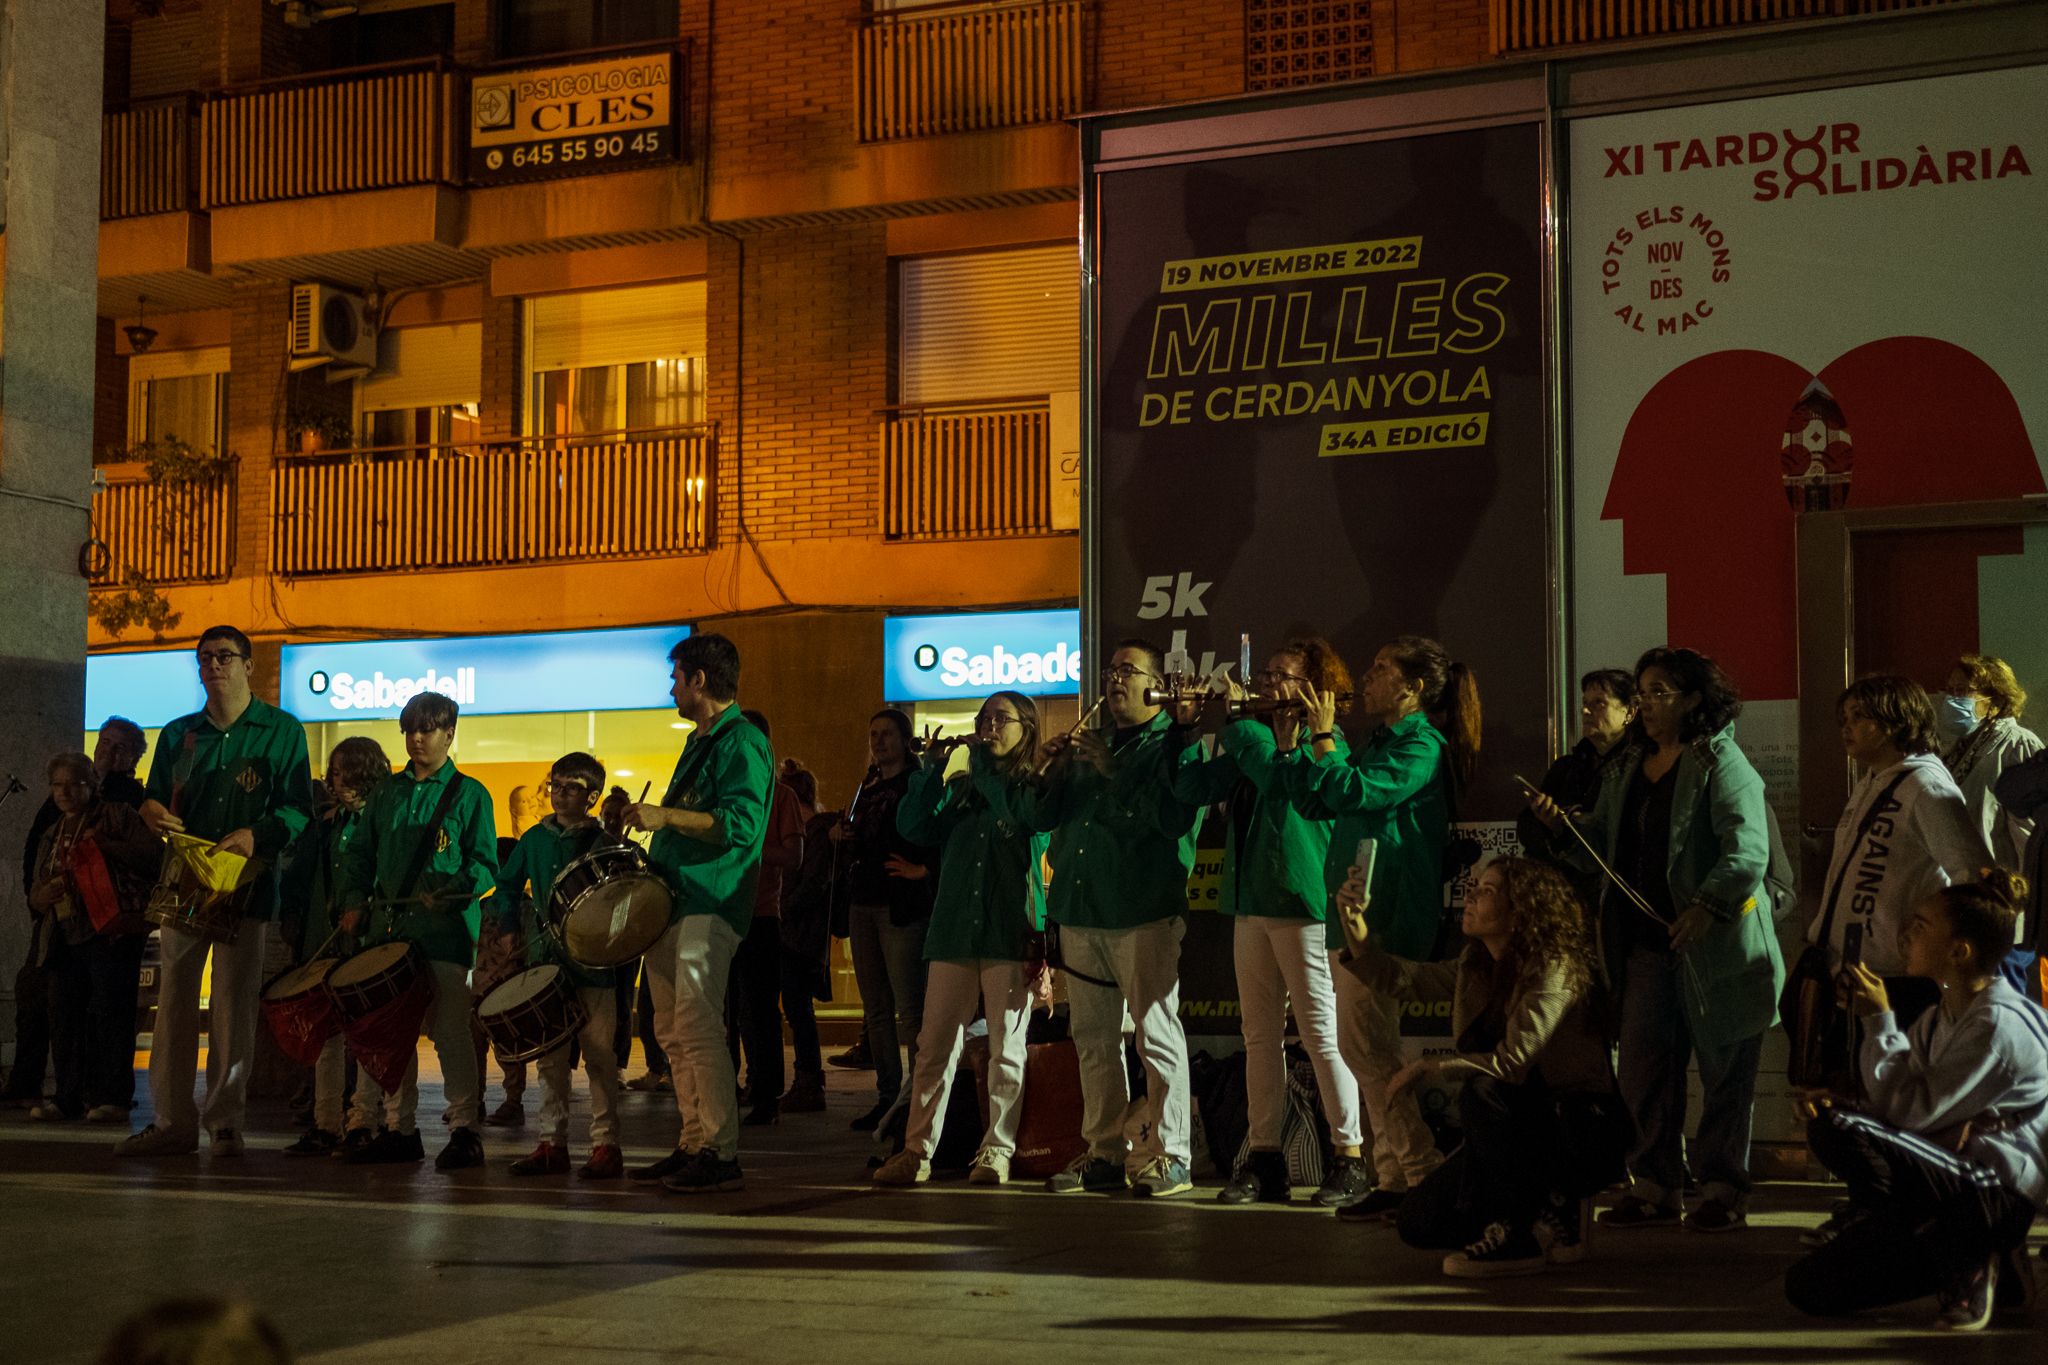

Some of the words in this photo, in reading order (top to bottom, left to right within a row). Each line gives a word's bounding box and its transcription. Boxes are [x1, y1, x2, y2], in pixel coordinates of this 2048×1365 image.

[518, 64, 668, 103] PSICOLOGIA
[531, 92, 655, 132] CLES
[512, 143, 555, 167] 645
[560, 140, 588, 162] 55
[594, 135, 624, 158] 90
[630, 131, 660, 154] 45
[1603, 144, 1644, 178] XI
[1167, 262, 1191, 285] 19
[1199, 250, 1347, 282] NOVEMBRE
[1355, 243, 1417, 266] 2022
[1602, 227, 1634, 294] TOTS
[1636, 206, 1684, 230] ELS
[1689, 212, 1731, 284] MONS
[1648, 241, 1684, 264] NOV
[1650, 278, 1683, 300] DES
[1146, 272, 1512, 379] MILLES
[1614, 304, 1645, 332] AL
[1658, 300, 1714, 336] MAC
[1138, 390, 1194, 427] DE
[1205, 366, 1492, 421] CERDANYOLA
[1326, 427, 1377, 451] 34A
[1387, 417, 1482, 446] EDICIÓ
[1137, 572, 1213, 620] 5k
